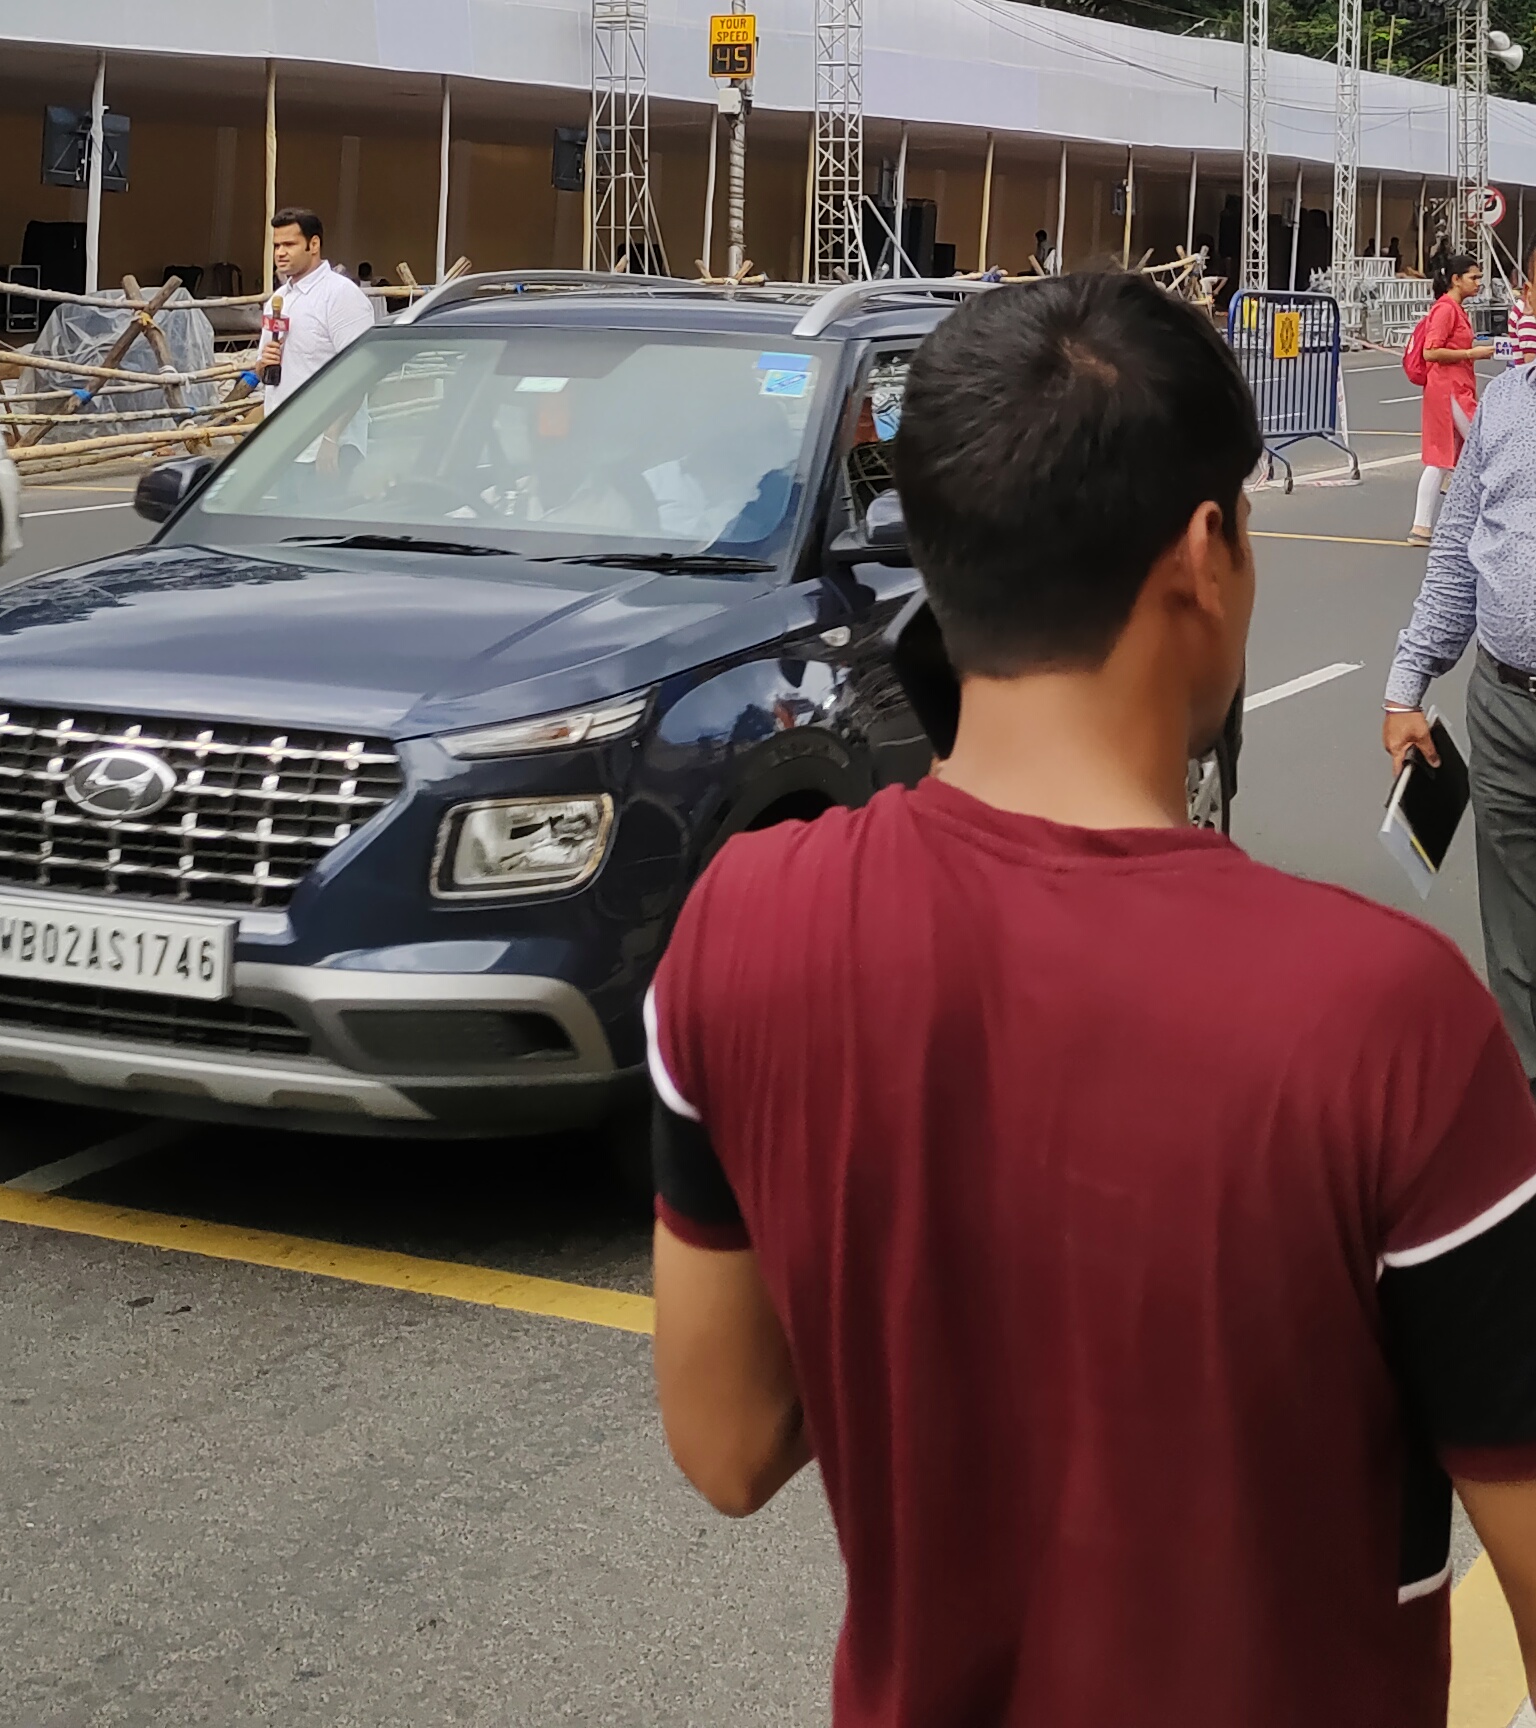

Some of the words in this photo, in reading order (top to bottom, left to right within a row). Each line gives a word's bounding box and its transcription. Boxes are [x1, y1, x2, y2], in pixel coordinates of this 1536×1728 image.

[720, 18, 747, 29] YOUR
[716, 31, 749, 42] SPEED
[716, 46, 748, 72] 45
